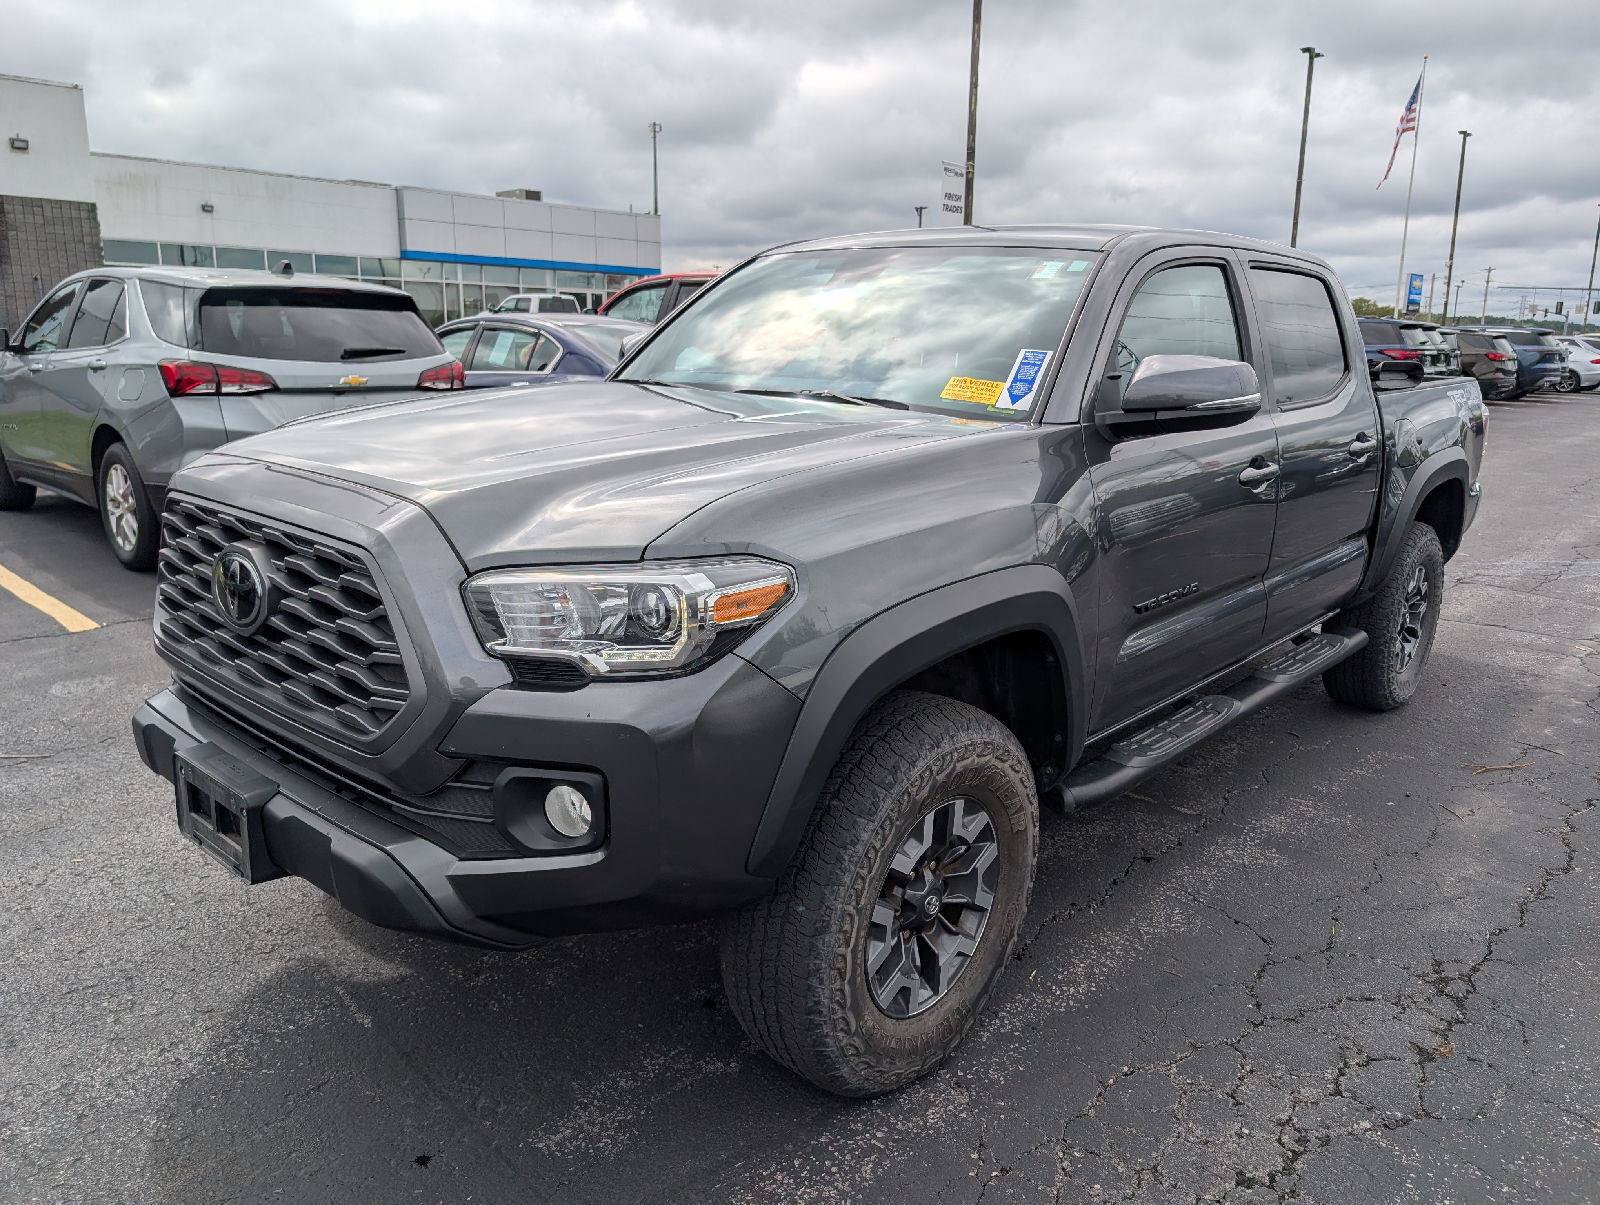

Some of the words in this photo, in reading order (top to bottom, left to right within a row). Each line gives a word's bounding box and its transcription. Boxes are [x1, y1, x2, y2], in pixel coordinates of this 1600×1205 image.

[944, 192, 962, 202] FRESH
[942, 203, 963, 214] TRADES
[969, 379, 1000, 389] VEHICLE
[1133, 582, 1199, 614] TACOMA
